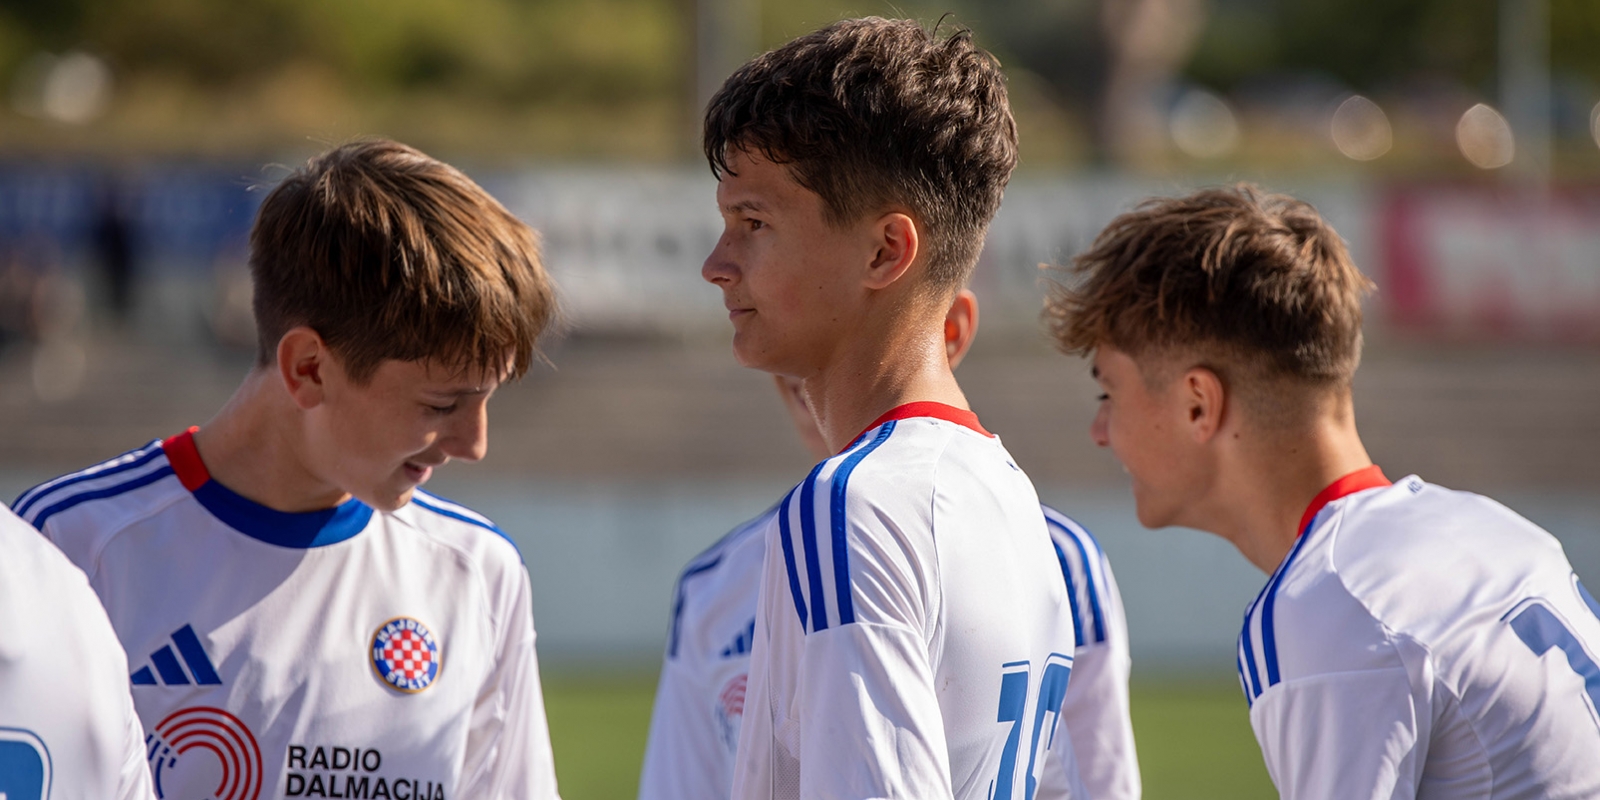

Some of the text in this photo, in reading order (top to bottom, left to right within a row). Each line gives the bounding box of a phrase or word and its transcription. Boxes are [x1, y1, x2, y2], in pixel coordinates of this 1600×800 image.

[376, 619, 434, 645] HAJDUK
[385, 672, 431, 689] SPLIT
[287, 745, 381, 773] RADIO
[284, 773, 445, 800] DALMACIJA
